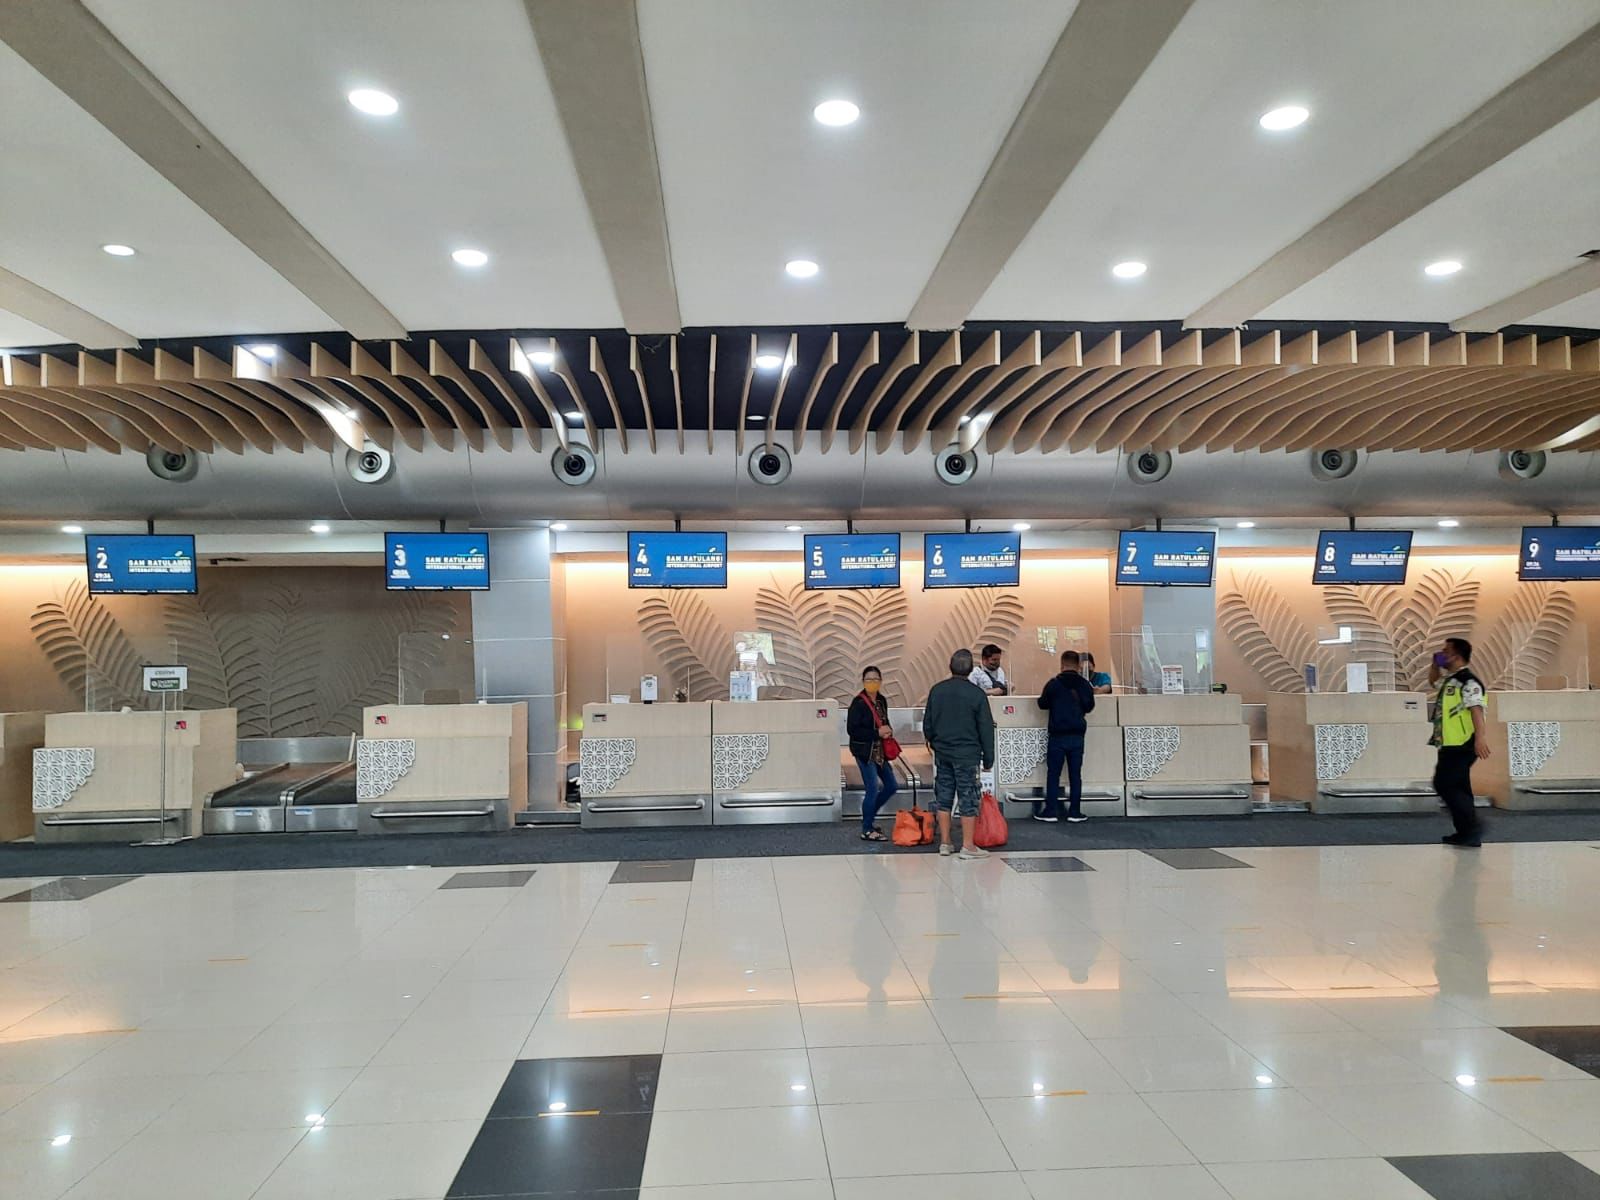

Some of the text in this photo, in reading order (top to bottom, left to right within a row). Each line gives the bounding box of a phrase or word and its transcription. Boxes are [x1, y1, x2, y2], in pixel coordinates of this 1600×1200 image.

[394, 549, 406, 566] 3
[637, 548, 648, 564] 4
[813, 551, 823, 566] 5
[933, 550, 943, 566] 6
[1126, 547, 1137, 562] 7
[1324, 546, 1336, 562] 8
[1529, 543, 1540, 558] 9
[97, 552, 108, 569] 2
